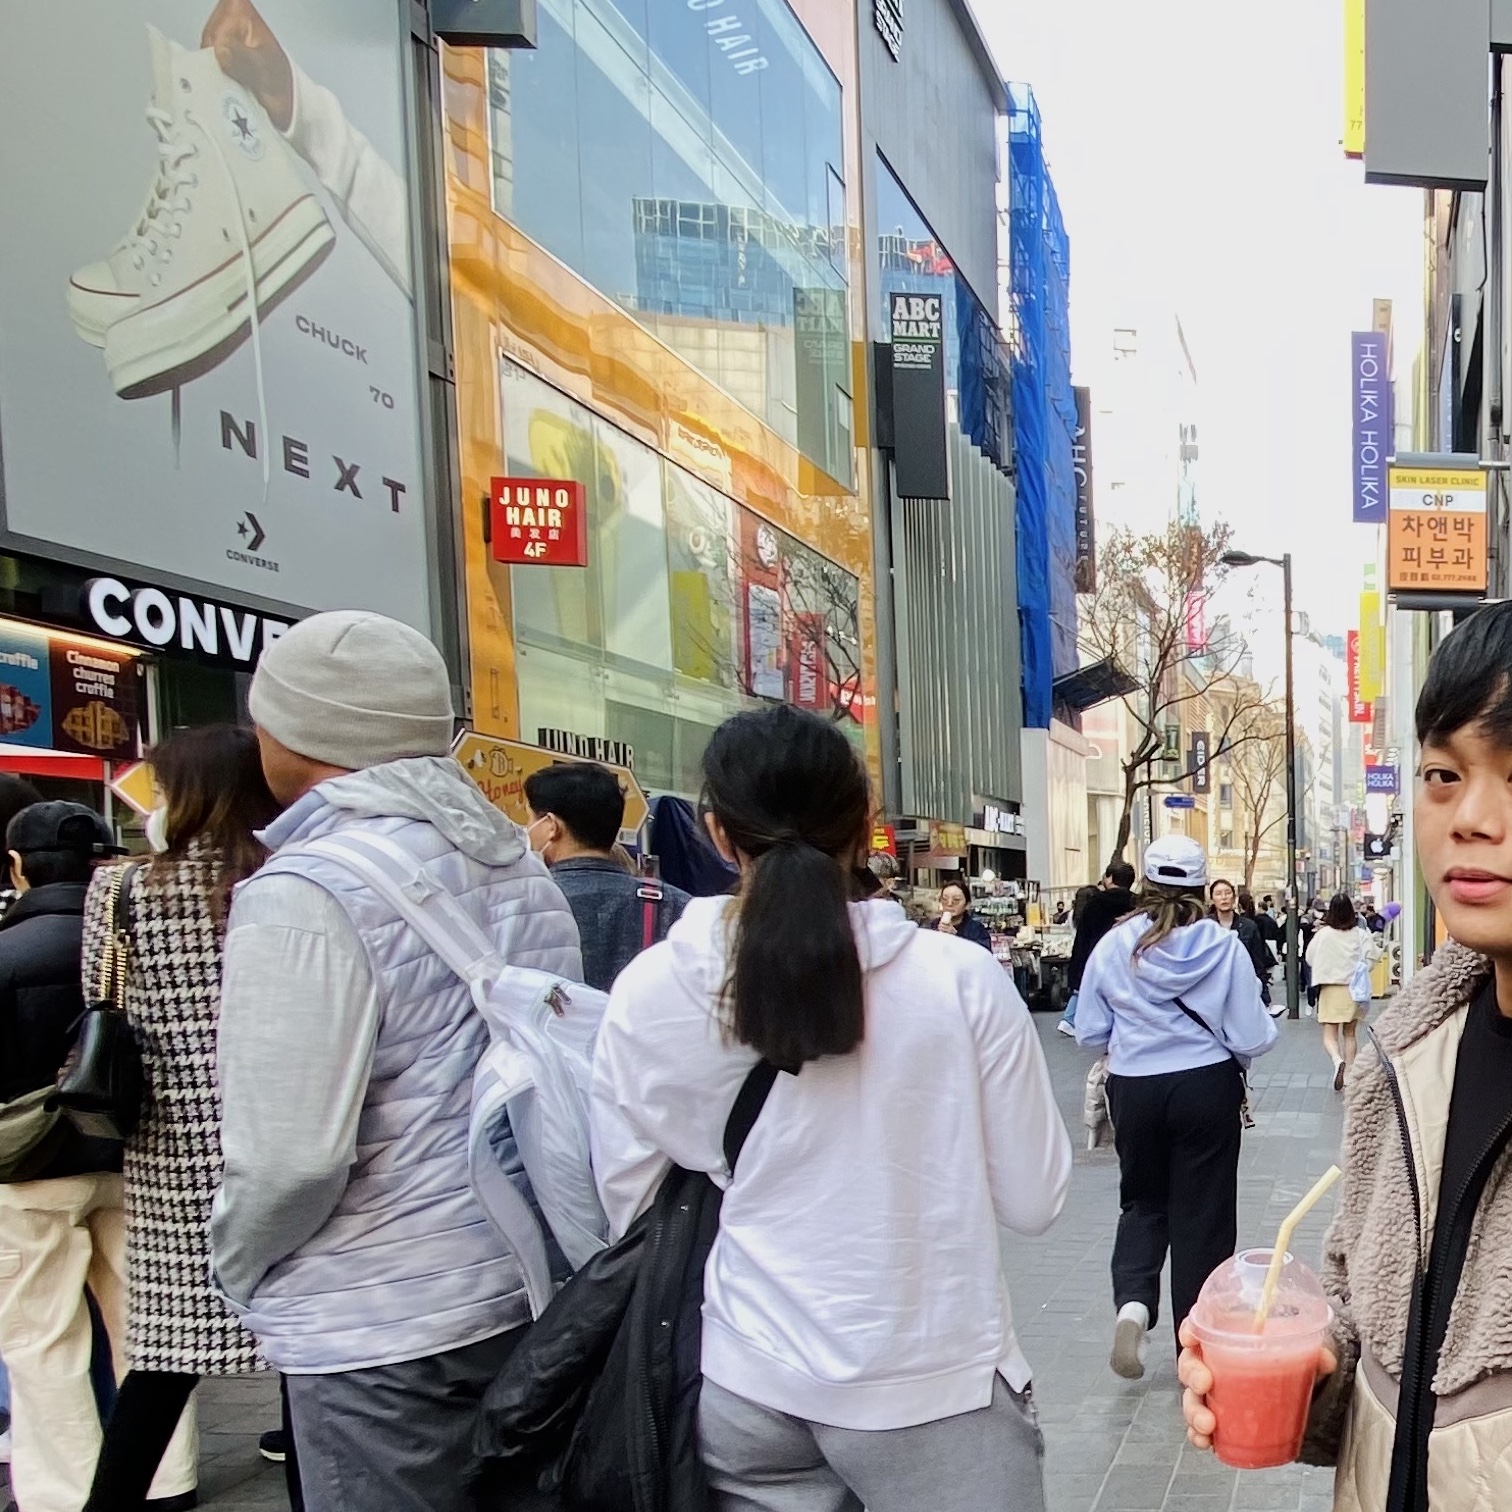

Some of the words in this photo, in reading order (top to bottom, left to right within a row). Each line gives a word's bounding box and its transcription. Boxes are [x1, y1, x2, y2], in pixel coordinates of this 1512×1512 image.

[705, 15, 769, 76] HAIR
[892, 297, 941, 321] ABC
[295, 314, 369, 365] CHUCK
[892, 320, 941, 337] MART
[893, 343, 935, 354] GRAND
[894, 352, 931, 362] STAGE
[1360, 342, 1379, 424] HOLIKA
[369, 385, 395, 410] 70
[219, 409, 407, 513] NEXT
[1360, 430, 1379, 510] HOLIKA
[1396, 475, 1417, 484] SKIN
[1420, 476, 1448, 485] LASER
[1450, 477, 1479, 486] CLINIC
[499, 486, 570, 508] JUNO
[1422, 494, 1454, 507] CNP
[506, 507, 562, 528] HAIR
[1402, 515, 1475, 543] 차앤박
[226, 549, 280, 573] CONVERSE
[524, 541, 547, 557] 4F
[1402, 546, 1475, 570] 피부과
